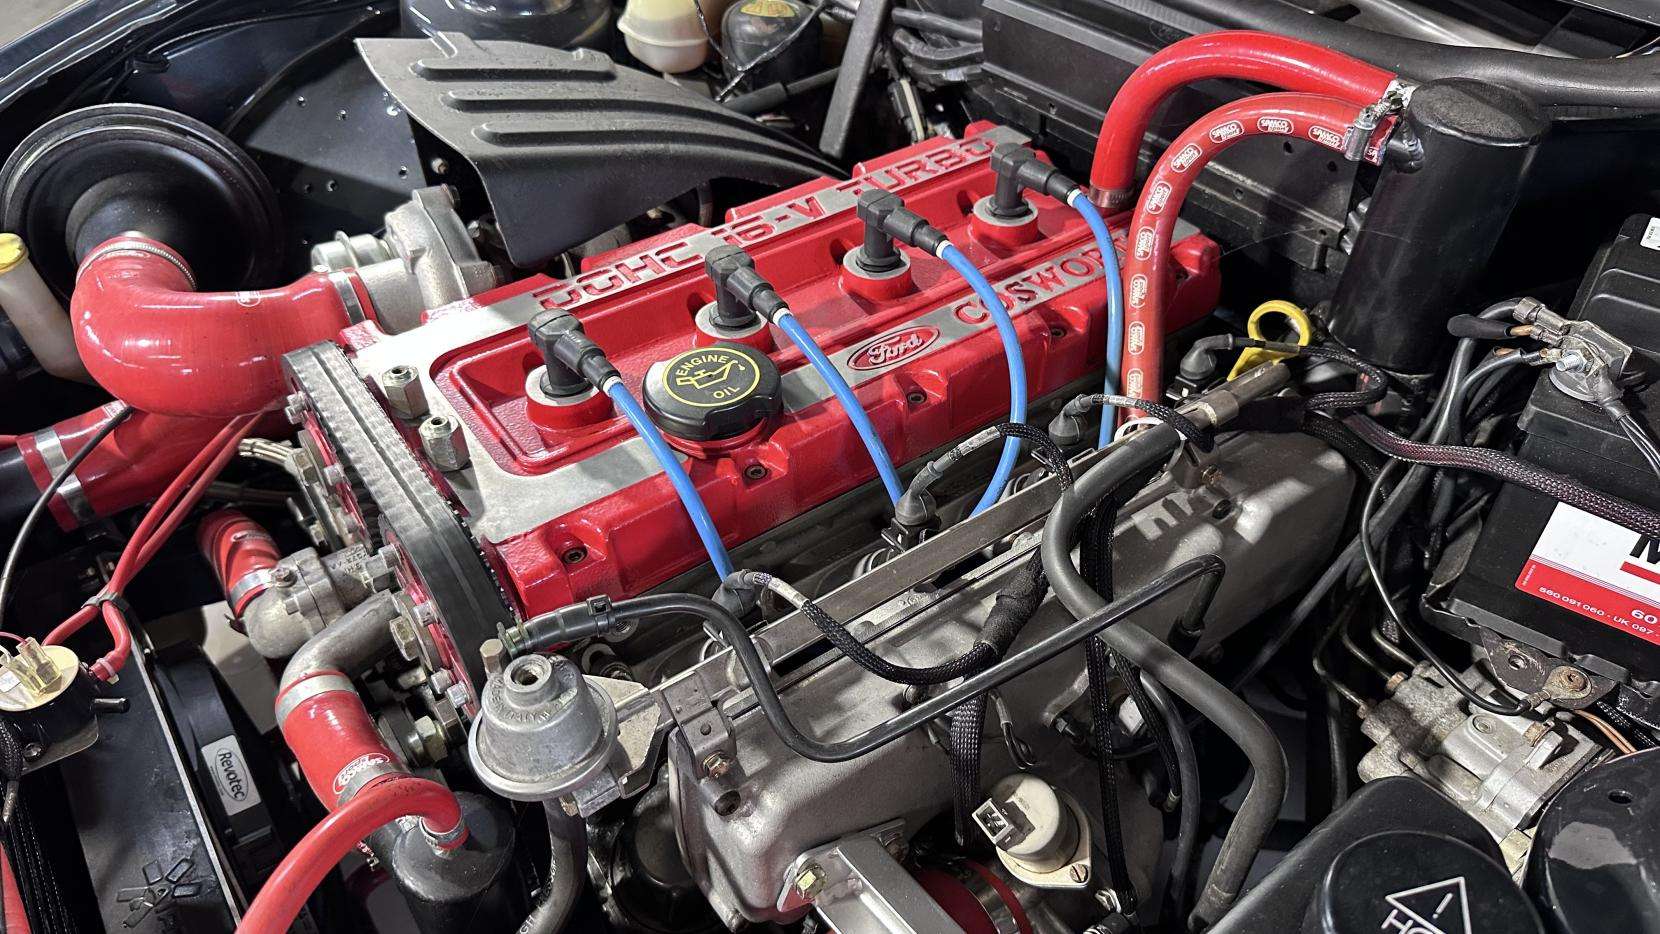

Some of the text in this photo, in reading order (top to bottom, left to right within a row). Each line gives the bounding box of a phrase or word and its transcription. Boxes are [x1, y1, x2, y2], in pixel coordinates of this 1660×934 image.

[1211, 123, 1238, 138] SAMCO
[1260, 118, 1287, 129] SAMCO
[1312, 127, 1339, 142] SAMCO
[1173, 147, 1193, 169] SAMCO
[532, 241, 704, 310] DOHC
[836, 137, 995, 194] TURBO
[867, 334, 923, 364] Ford
[676, 354, 730, 377] ENGINE
[713, 386, 740, 399] OIL
[1613, 616, 1630, 626] UK
[1631, 623, 1654, 635] 097
[1631, 609, 1658, 624] 60
[218, 752, 245, 799] Revotec
